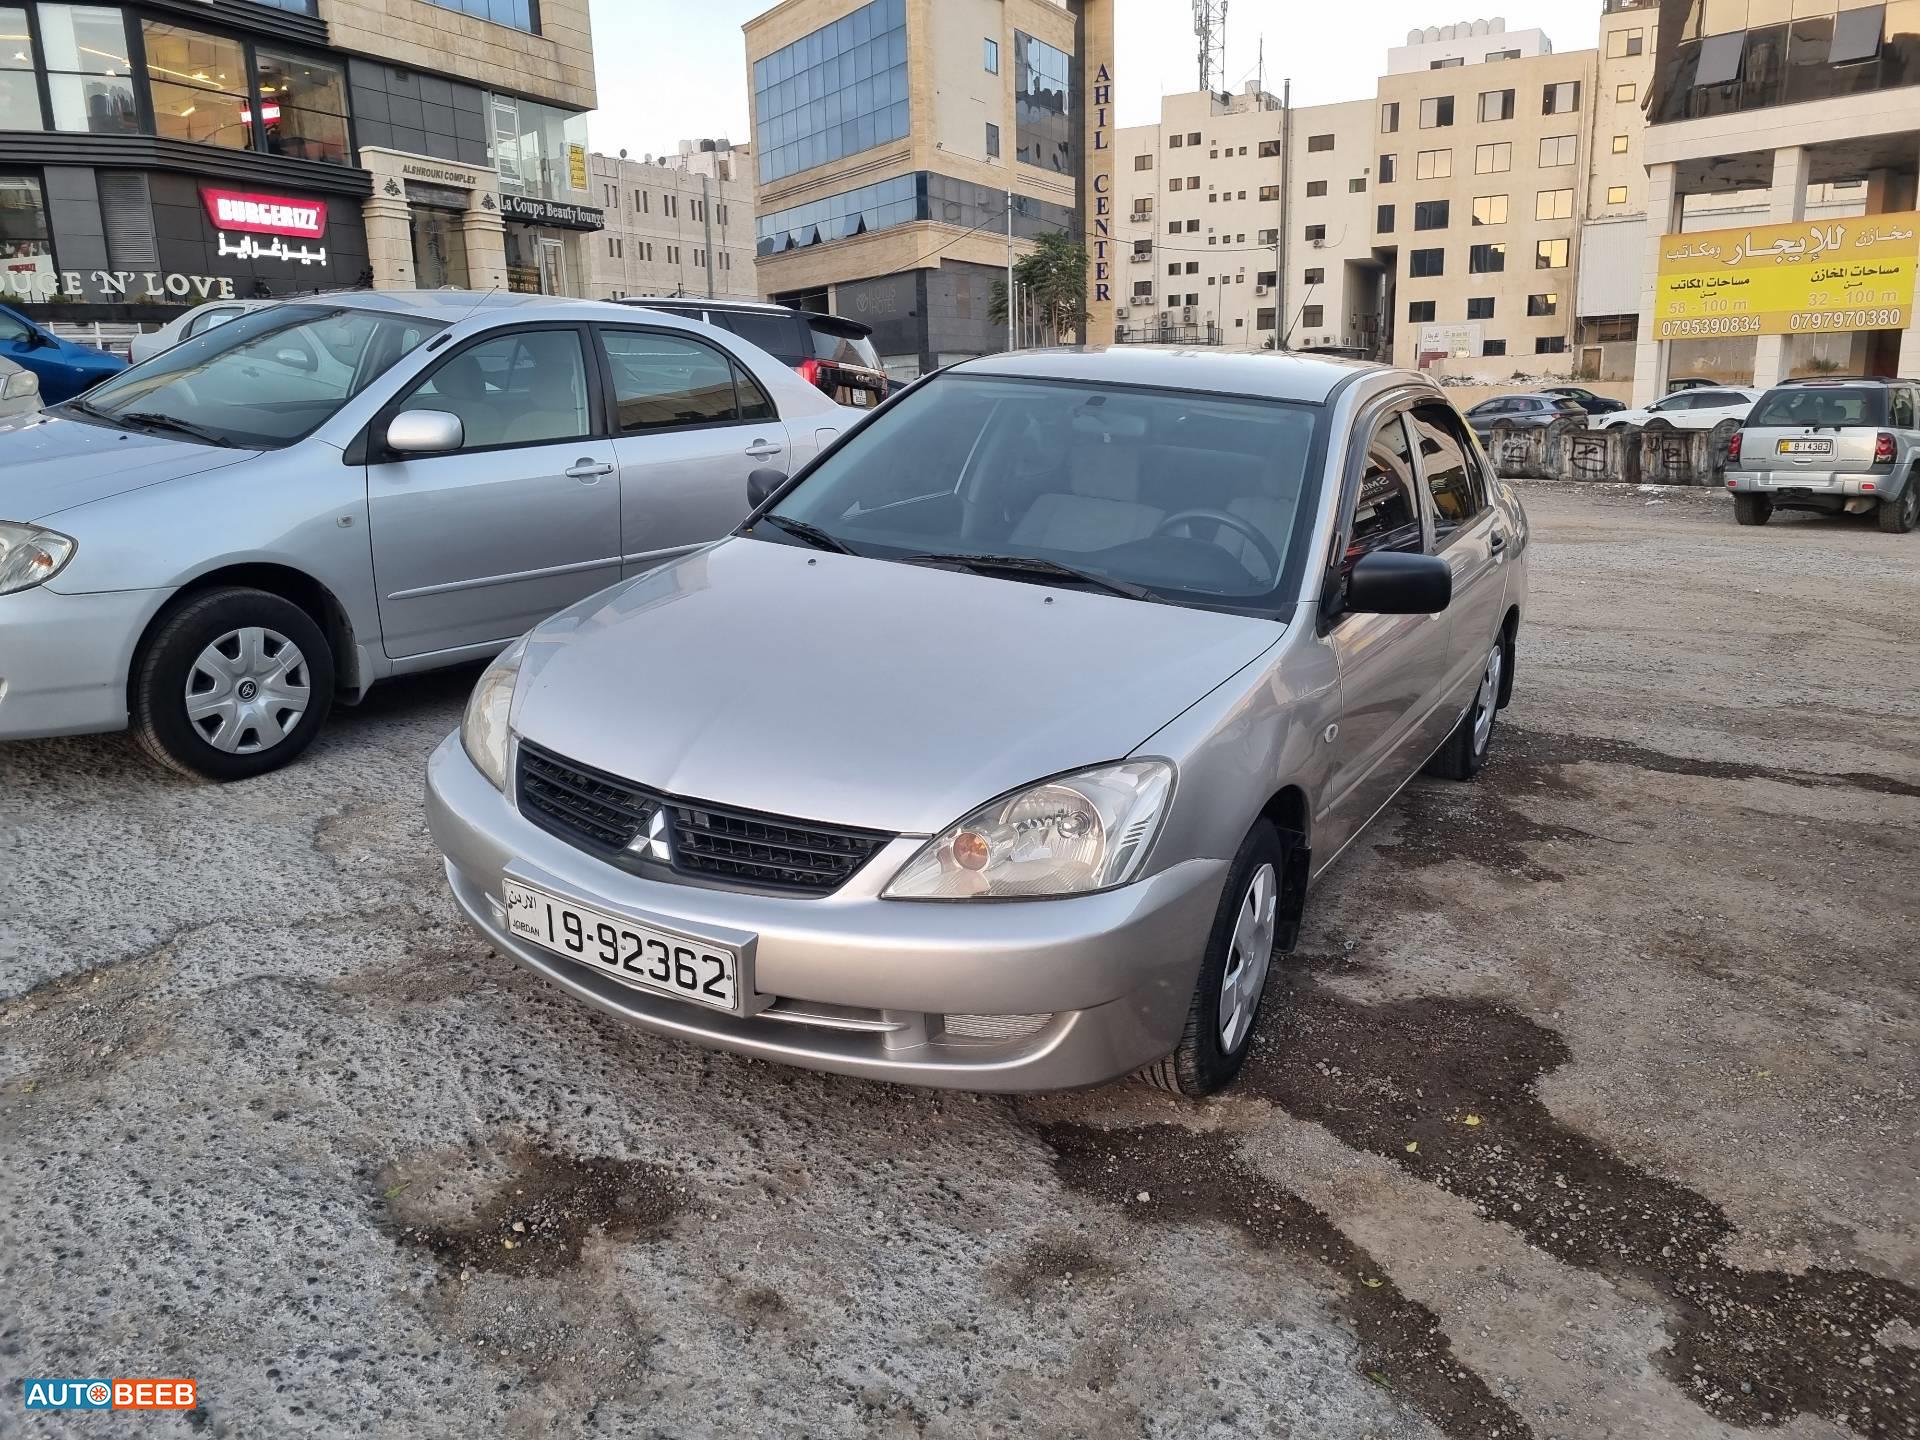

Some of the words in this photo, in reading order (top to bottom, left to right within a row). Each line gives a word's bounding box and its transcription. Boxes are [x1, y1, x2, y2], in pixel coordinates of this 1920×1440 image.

[1094, 63, 1111, 150] AHIL
[403, 164, 443, 179] ALSHROUKI
[444, 172, 477, 185] COMPLEX
[500, 194, 512, 211] La
[513, 197, 545, 220] Coupe
[547, 202, 577, 223] Beauty
[577, 206, 605, 227] lounge
[1094, 174, 1111, 302] CENTER
[1855, 225, 1913, 247] مخازن
[1666, 241, 1721, 262] ومكاتب
[1810, 268, 1848, 282] المخازن
[1850, 265, 1900, 277] مساحات
[0, 270, 83, 296] UGE
[143, 272, 236, 300] LOVE
[1670, 279, 1704, 292] المكاتب
[1706, 276, 1750, 288] مساحات
[1703, 299, 1728, 312] 100
[1808, 292, 1829, 307] 32
[1846, 289, 1875, 304] 100
[1662, 314, 1760, 336] 0795390834
[1790, 307, 1900, 330] 0797970380
[1794, 442, 1829, 451] 8-14383
[512, 919, 540, 937] JORDAN
